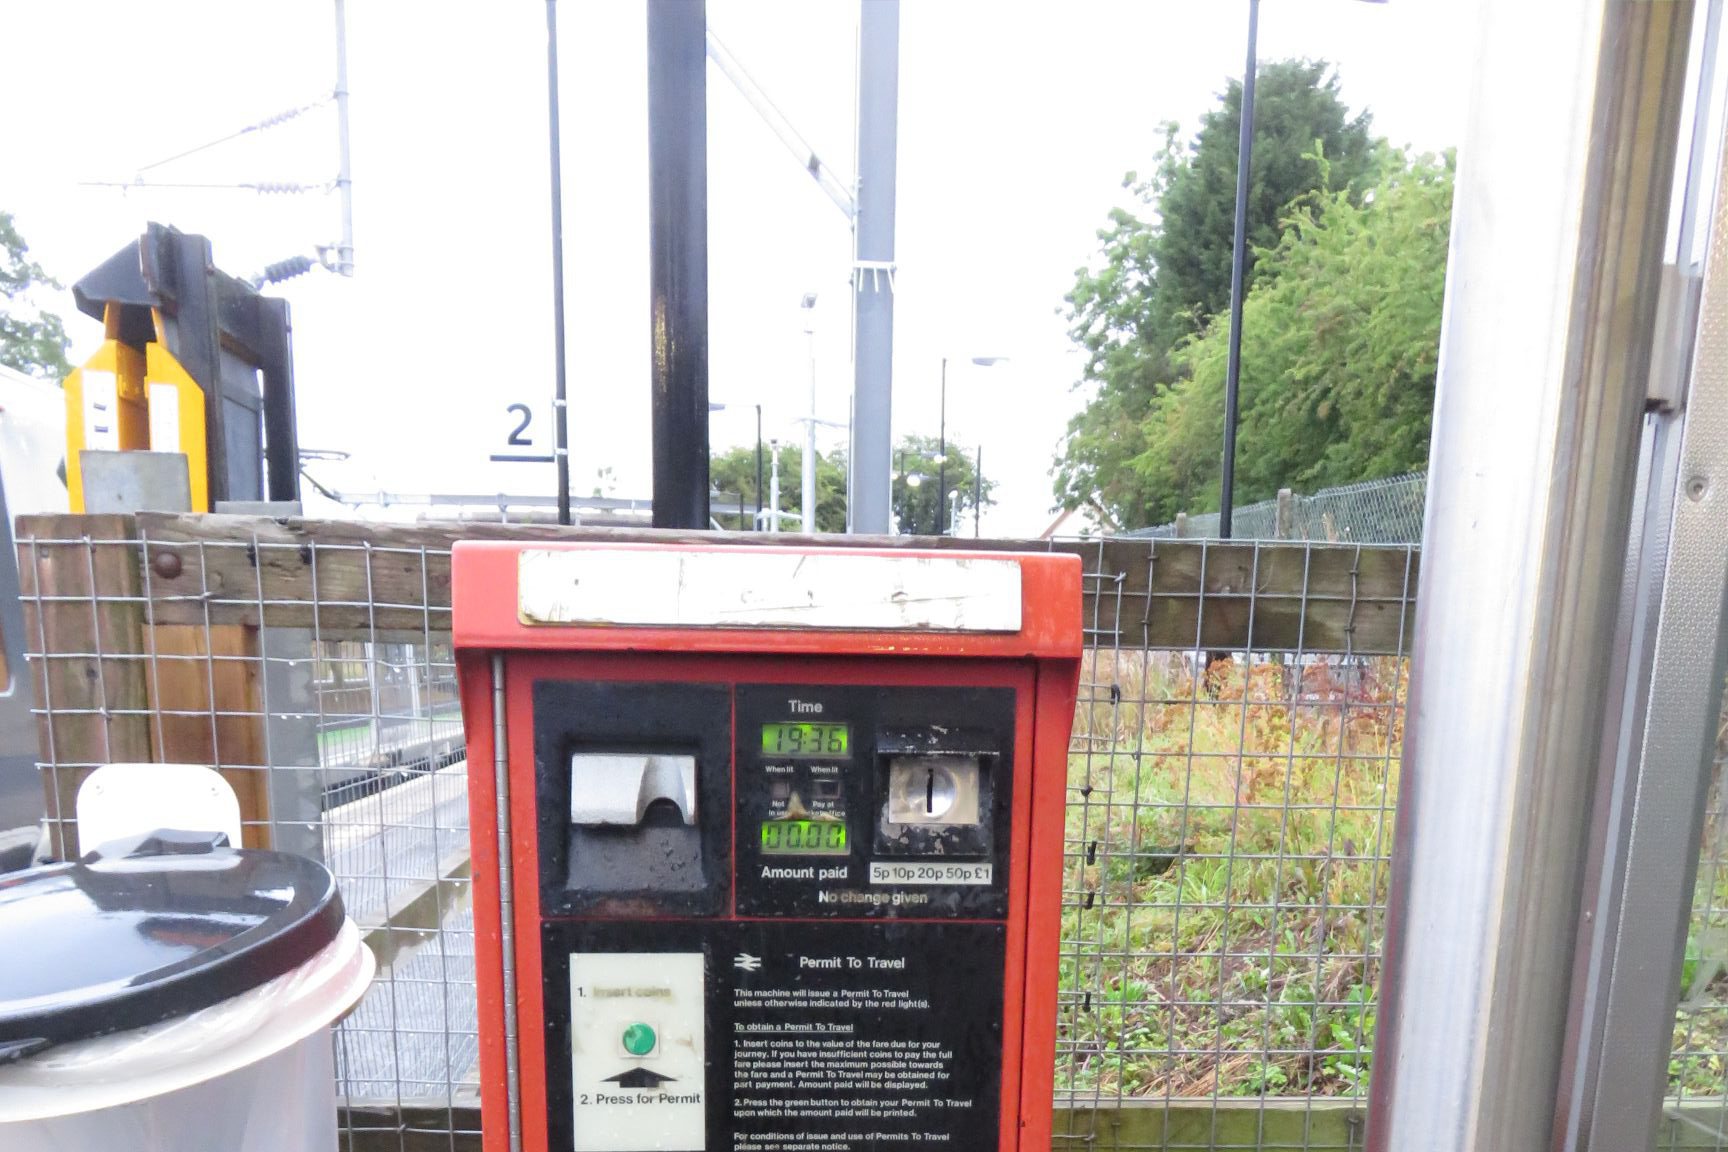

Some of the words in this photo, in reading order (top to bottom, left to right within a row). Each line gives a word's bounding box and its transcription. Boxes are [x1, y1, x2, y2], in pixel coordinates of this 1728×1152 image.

[506, 404, 531, 446] 2
[788, 700, 823, 712] Time
[777, 728, 842, 752] 19:36
[761, 866, 814, 878] Amount
[819, 866, 847, 880] paid
[873, 867, 890, 880] 5p
[893, 867, 915, 880] 10p
[918, 867, 943, 880] 20p
[946, 867, 971, 880] 50p
[975, 867, 990, 878] £1
[819, 891, 838, 903] No
[840, 891, 890, 905] change
[892, 891, 928, 905] given
[800, 957, 841, 968] Permit
[846, 957, 862, 968] To
[868, 957, 905, 968] Travel
[578, 987, 586, 997] 1.
[734, 989, 752, 997] This
[755, 989, 790, 997] machine
[792, 989, 806, 997] will
[808, 989, 830, 997] issue
[841, 989, 869, 997] Permit
[872, 989, 882, 997] To
[884, 989, 909, 997] Travel
[734, 999, 762, 1007] unless
[764, 999, 807, 1007] otherwise
[810, 999, 849, 1007] indicated
[852, 999, 862, 1009] by
[865, 999, 879, 1007] the
[882, 999, 896, 1007] red
[898, 999, 930, 1009] light(s).
[922, 1042, 940, 1050] your
[734, 1051, 769, 1060] journey.
[780, 1052, 794, 1060] you
[905, 1052, 920, 1060] pay
[753, 1061, 781, 1070] please
[871, 1061, 906, 1070] possible
[865, 1072, 882, 1080] may
[734, 1081, 752, 1090] part
[755, 1081, 795, 1090] payment.
[834, 1081, 852, 1090] paid
[884, 1081, 928, 1090] displayed.
[581, 1094, 592, 1104] 2.
[597, 1094, 633, 1104] Press
[637, 1094, 653, 1104] for
[659, 1094, 700, 1104] Permit
[734, 1110, 755, 1119] upon
[835, 1109, 853, 1119] paid
[884, 1109, 917, 1119] printed.
[734, 1143, 761, 1152] please
[783, 1143, 819, 1152] separate
